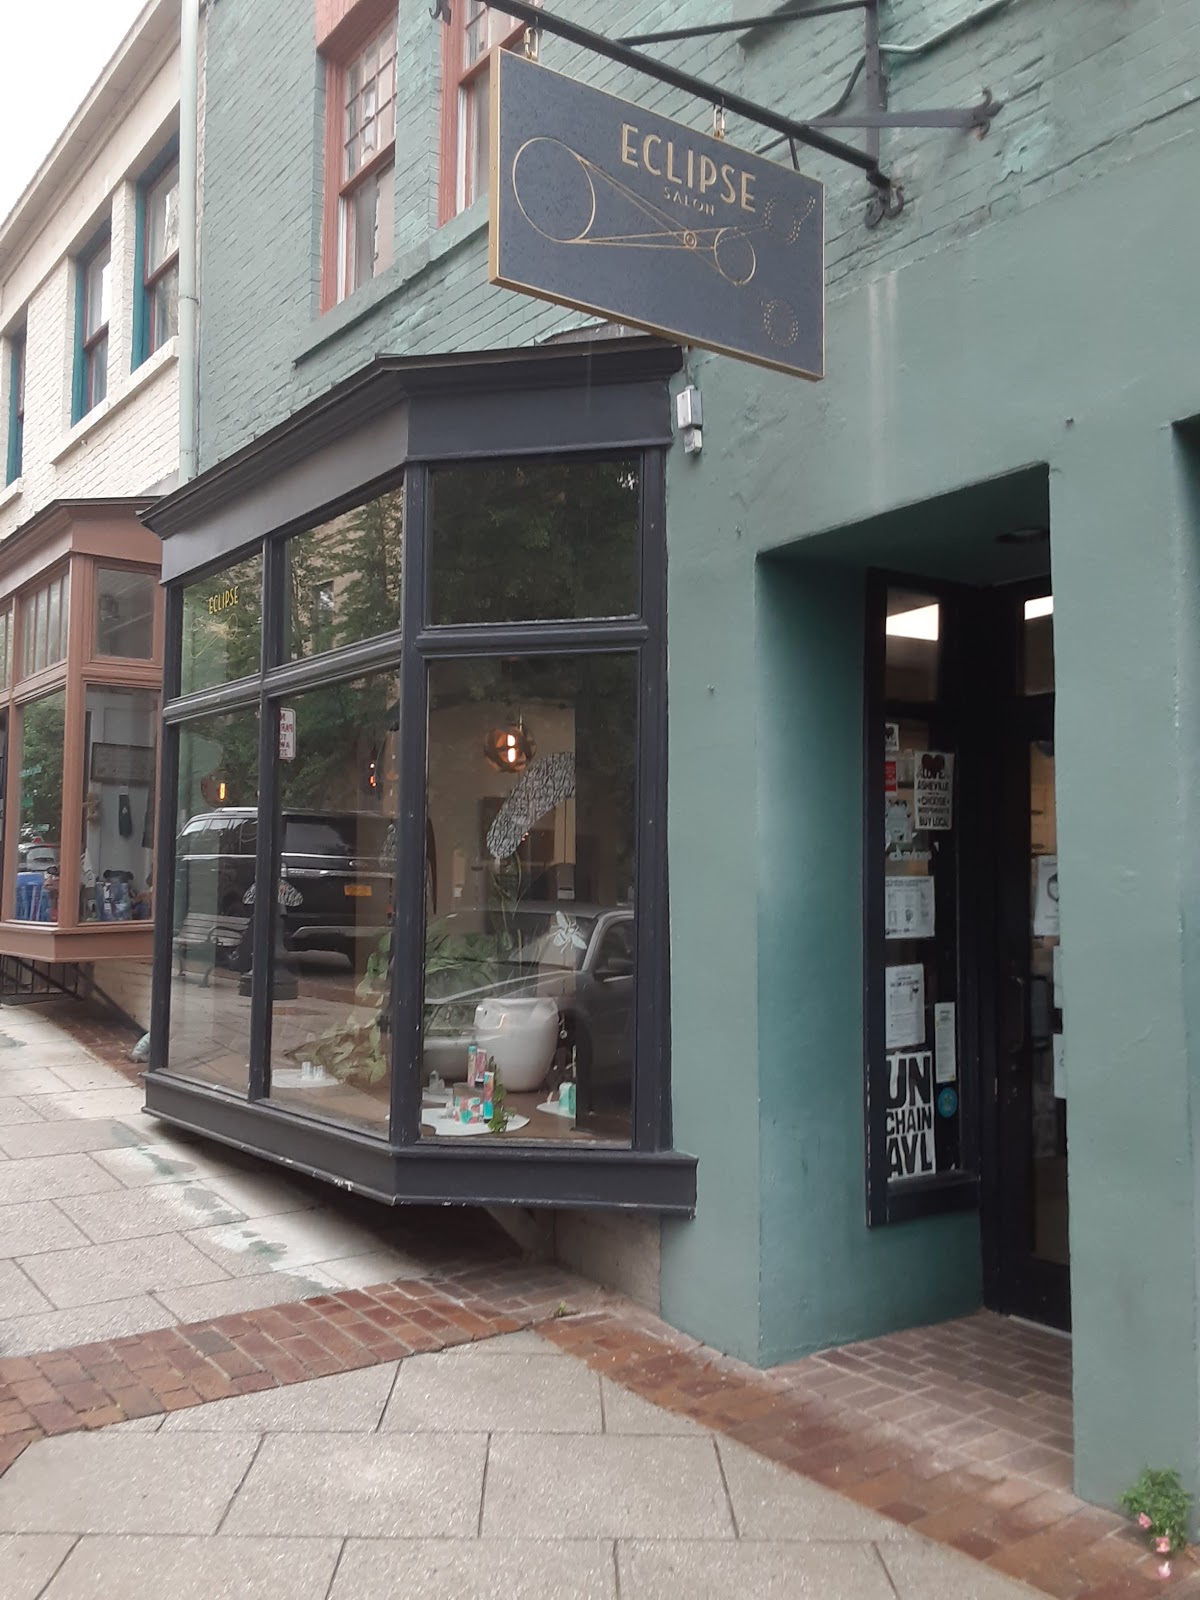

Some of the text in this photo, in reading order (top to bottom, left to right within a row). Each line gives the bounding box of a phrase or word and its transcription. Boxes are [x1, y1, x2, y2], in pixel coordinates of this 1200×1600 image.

[621, 122, 757, 213] ECLIPSE
[663, 186, 715, 217] SALON
[208, 586, 239, 614] ECLIPSE
[919, 816, 932, 827] BUY
[886, 1056, 932, 1108] UN
[886, 1106, 932, 1136] CHAIN
[887, 1132, 933, 1177] AVL
